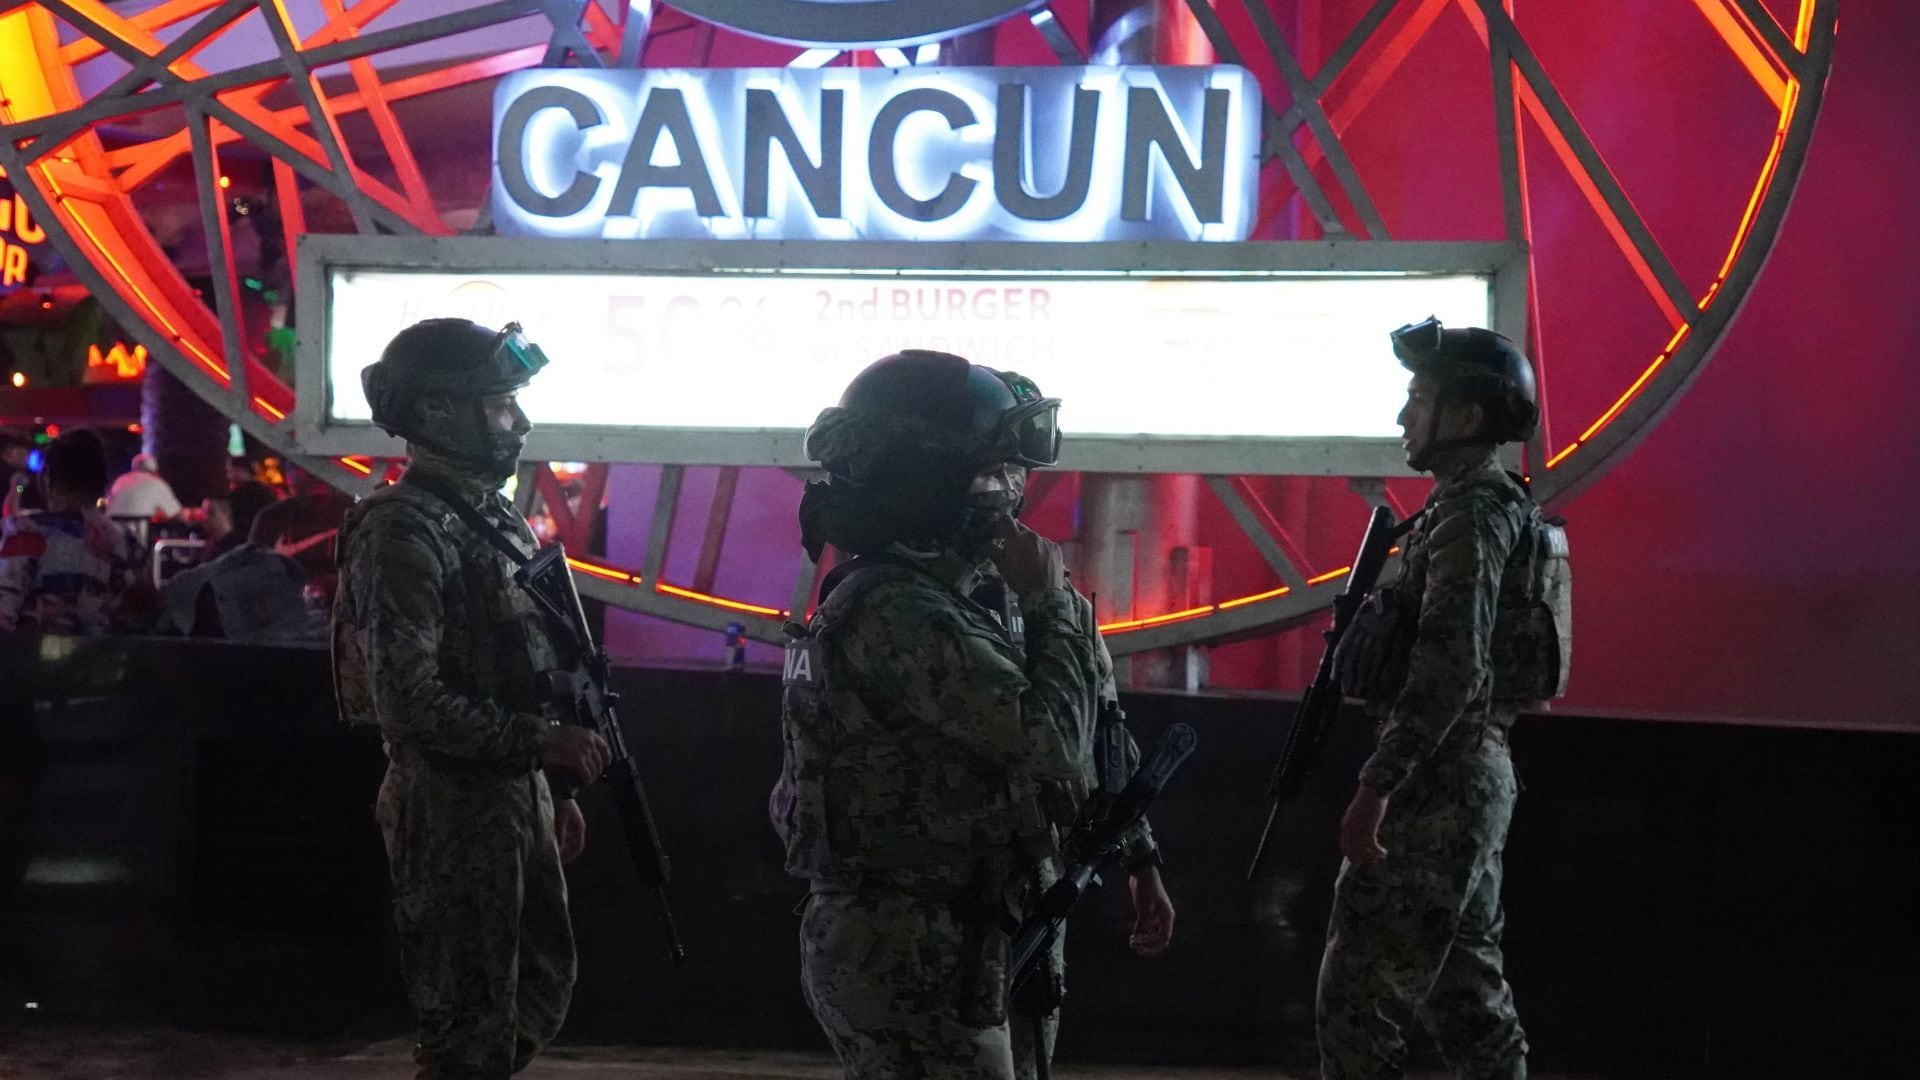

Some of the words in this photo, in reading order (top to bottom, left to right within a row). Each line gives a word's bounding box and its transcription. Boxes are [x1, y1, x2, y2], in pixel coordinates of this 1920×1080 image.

[497, 84, 1230, 224] CANCUN
[814, 287, 879, 321] 2nd
[890, 286, 1052, 321] BURGER
